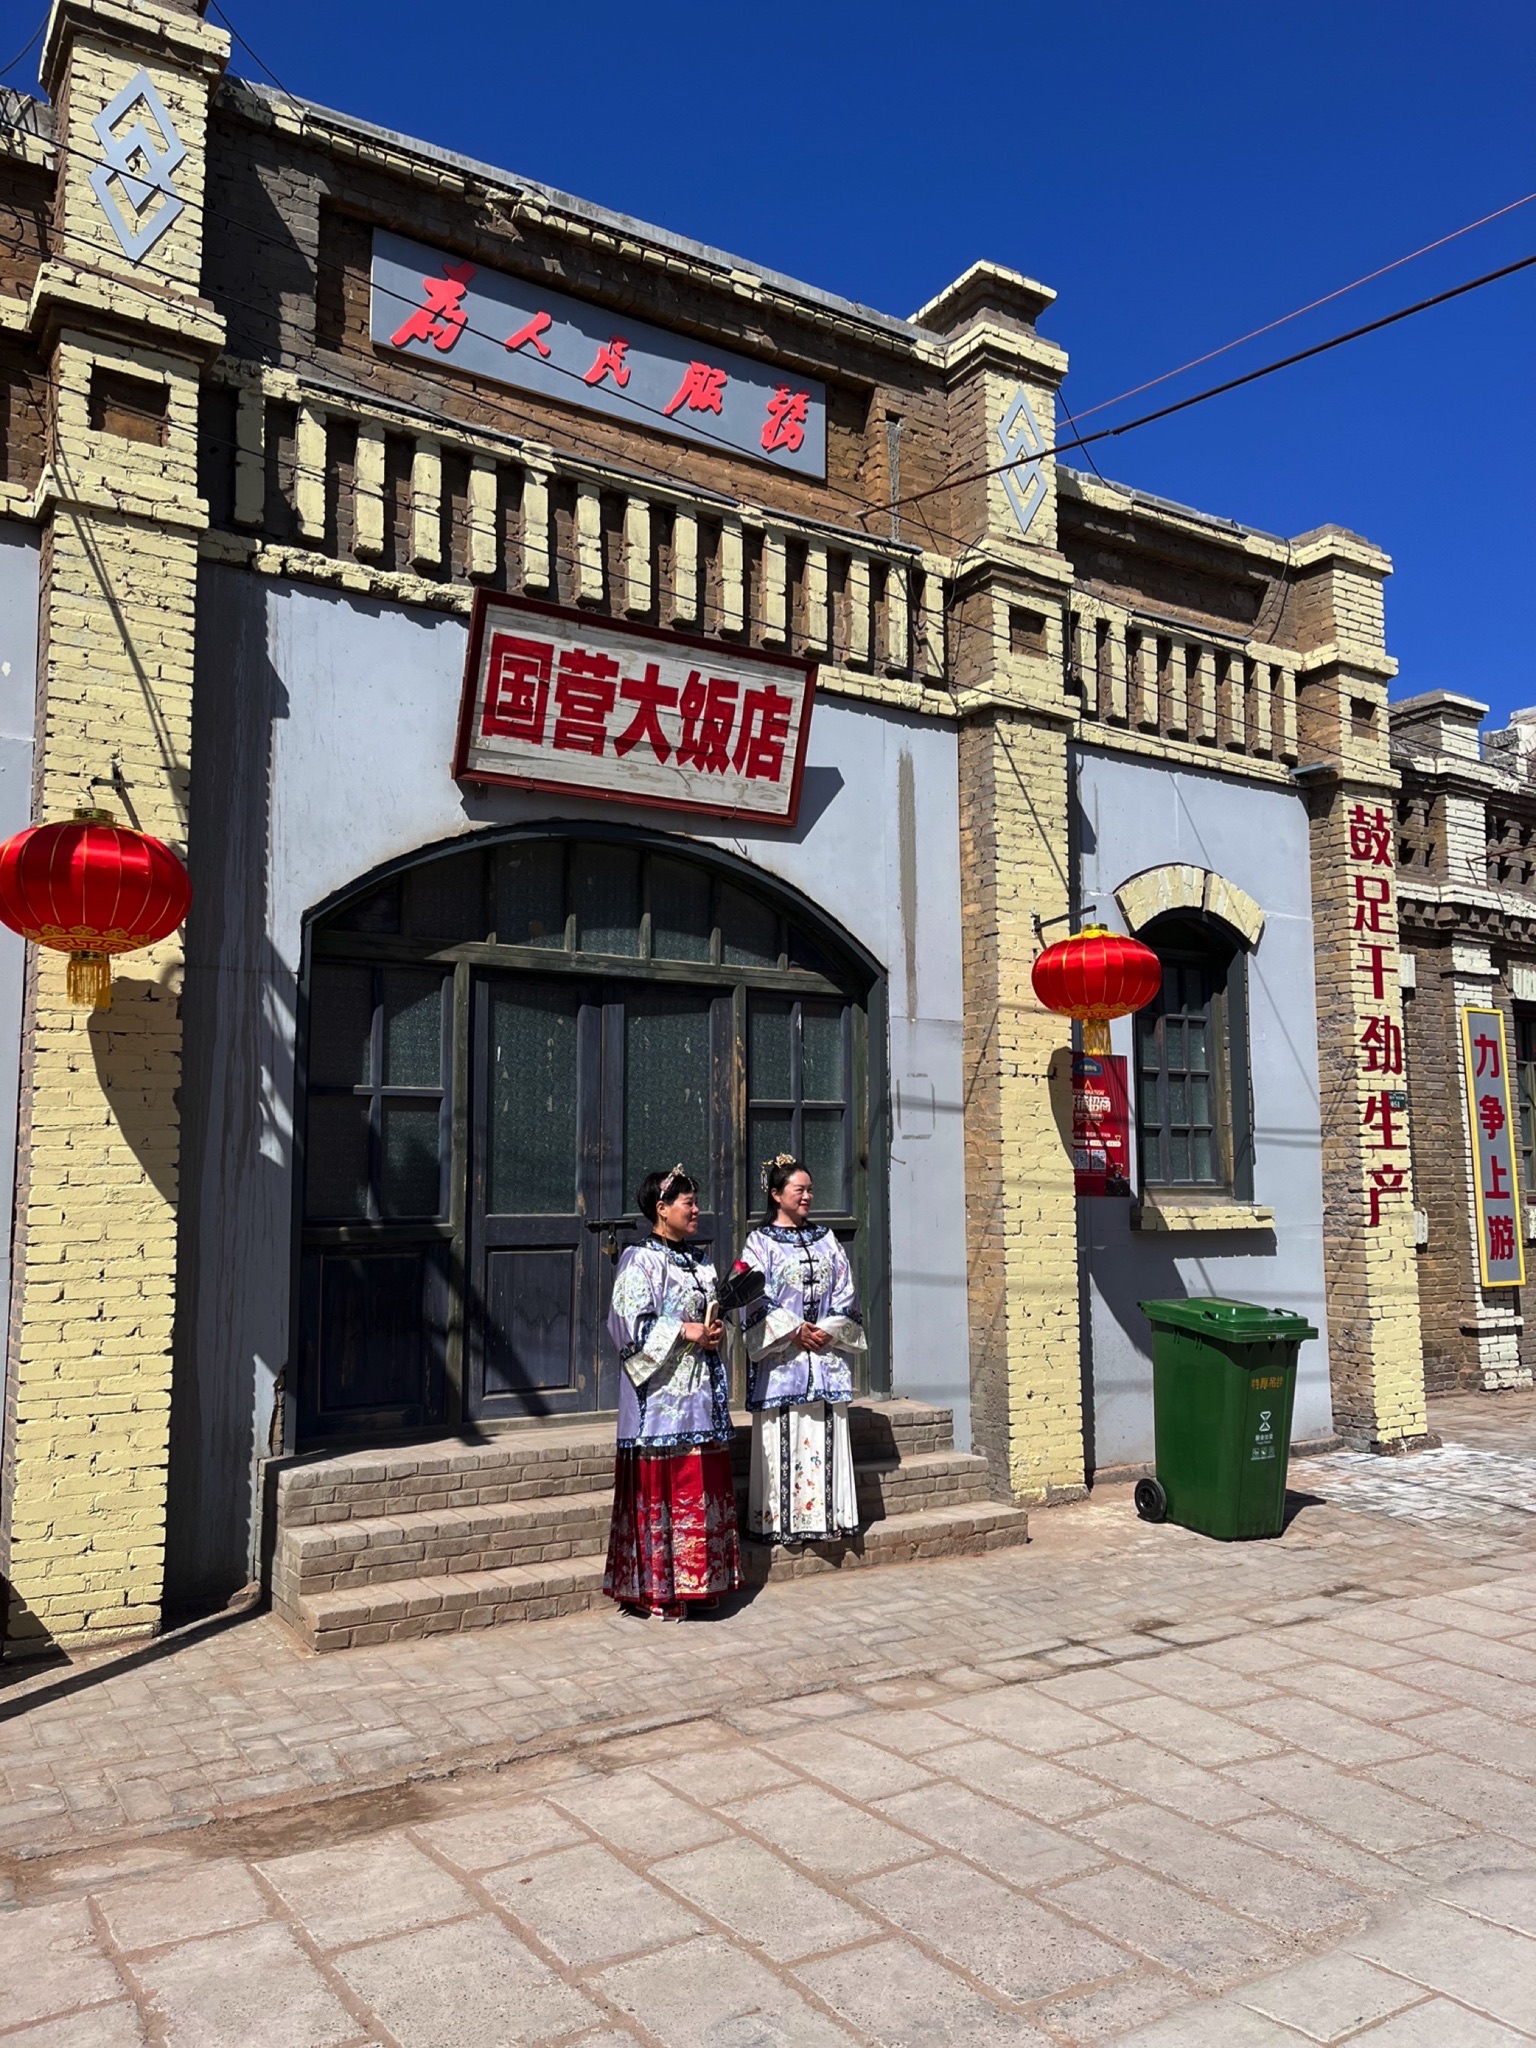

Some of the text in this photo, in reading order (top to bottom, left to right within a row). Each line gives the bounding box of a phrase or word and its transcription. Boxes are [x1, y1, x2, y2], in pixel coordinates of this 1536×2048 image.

[482, 632, 794, 783] 国营大饭店
[1348, 804, 1409, 1228] 鼓足干劲生产
[1474, 1034, 1515, 1261] 力争上游
